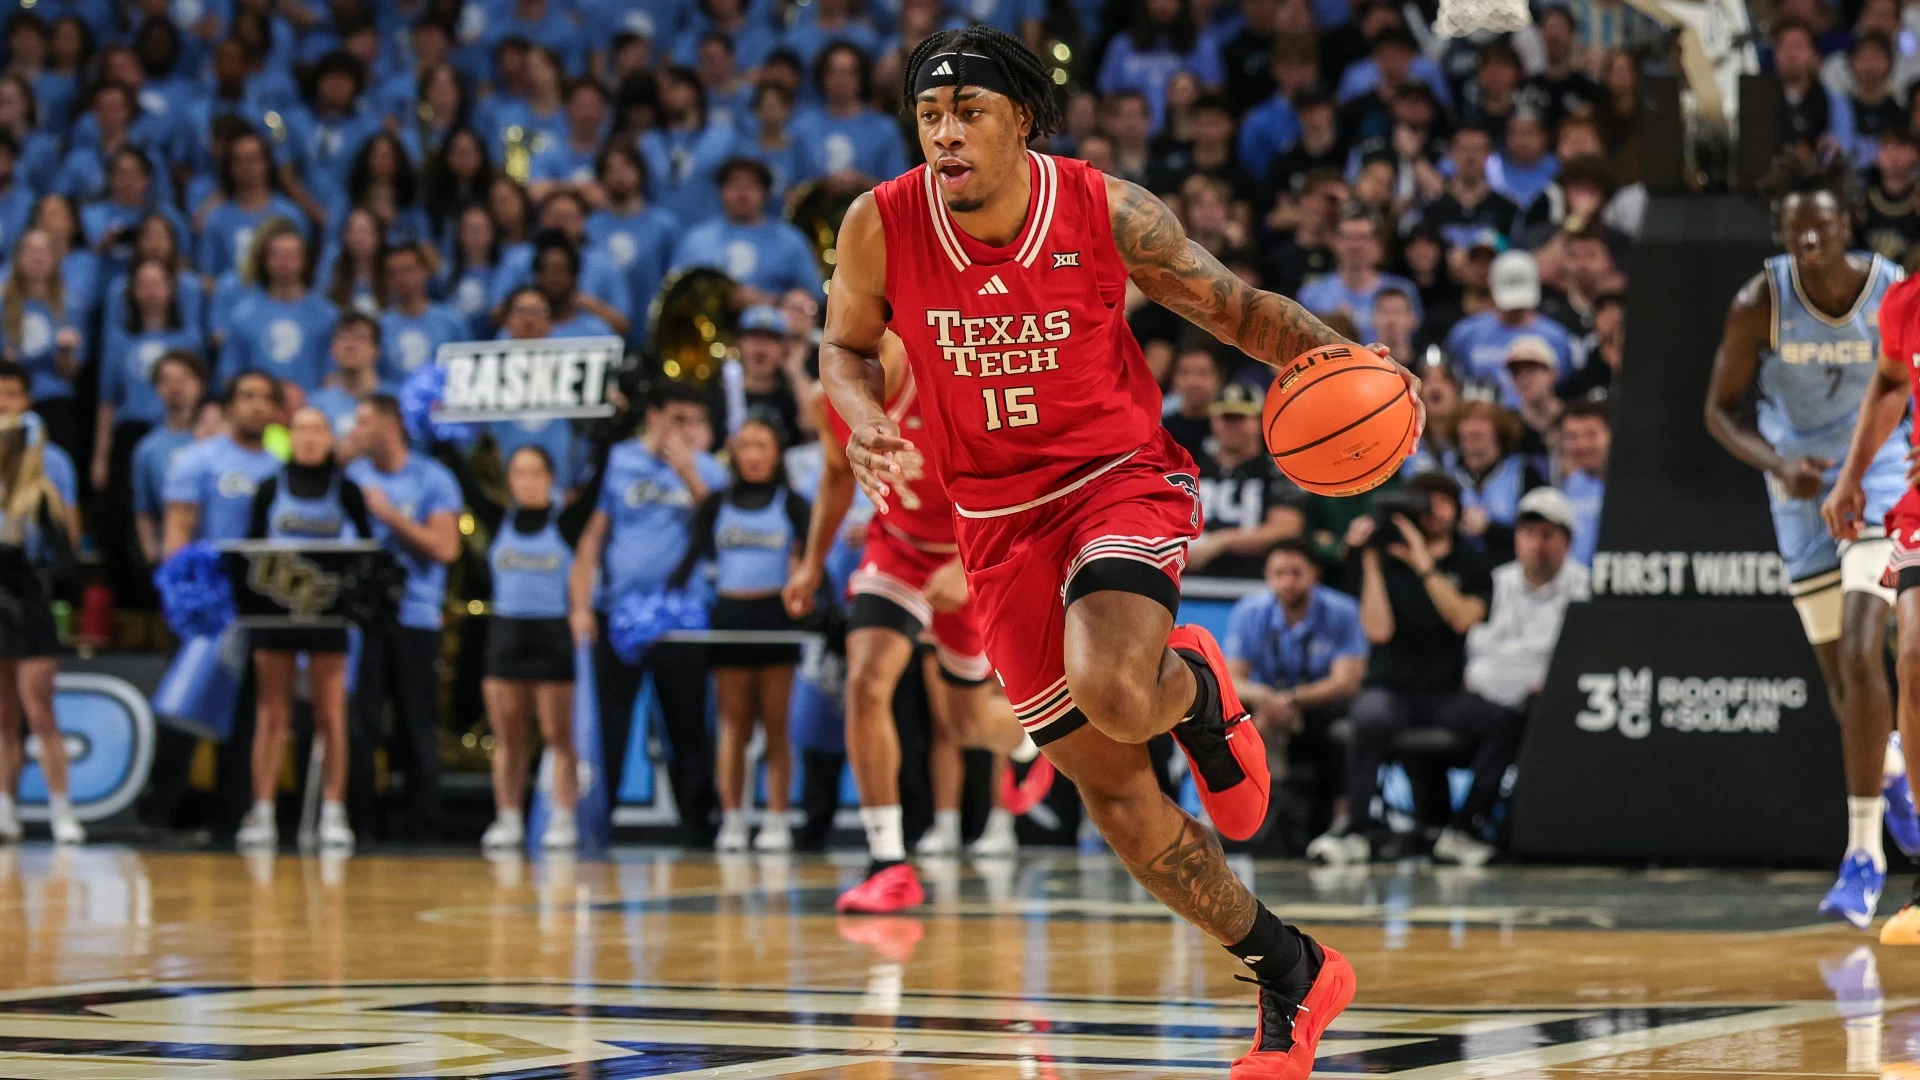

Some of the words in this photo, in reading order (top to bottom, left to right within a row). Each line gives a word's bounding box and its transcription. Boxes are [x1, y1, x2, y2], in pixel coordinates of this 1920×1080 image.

[1053, 252, 1080, 269] XII
[1780, 341, 1873, 364] SPACE
[444, 351, 608, 408] BASKET
[1824, 366, 1844, 400] 7
[982, 386, 1039, 432] 15
[1593, 552, 1687, 595] FIRST
[1658, 676, 1808, 709] ROOFING
